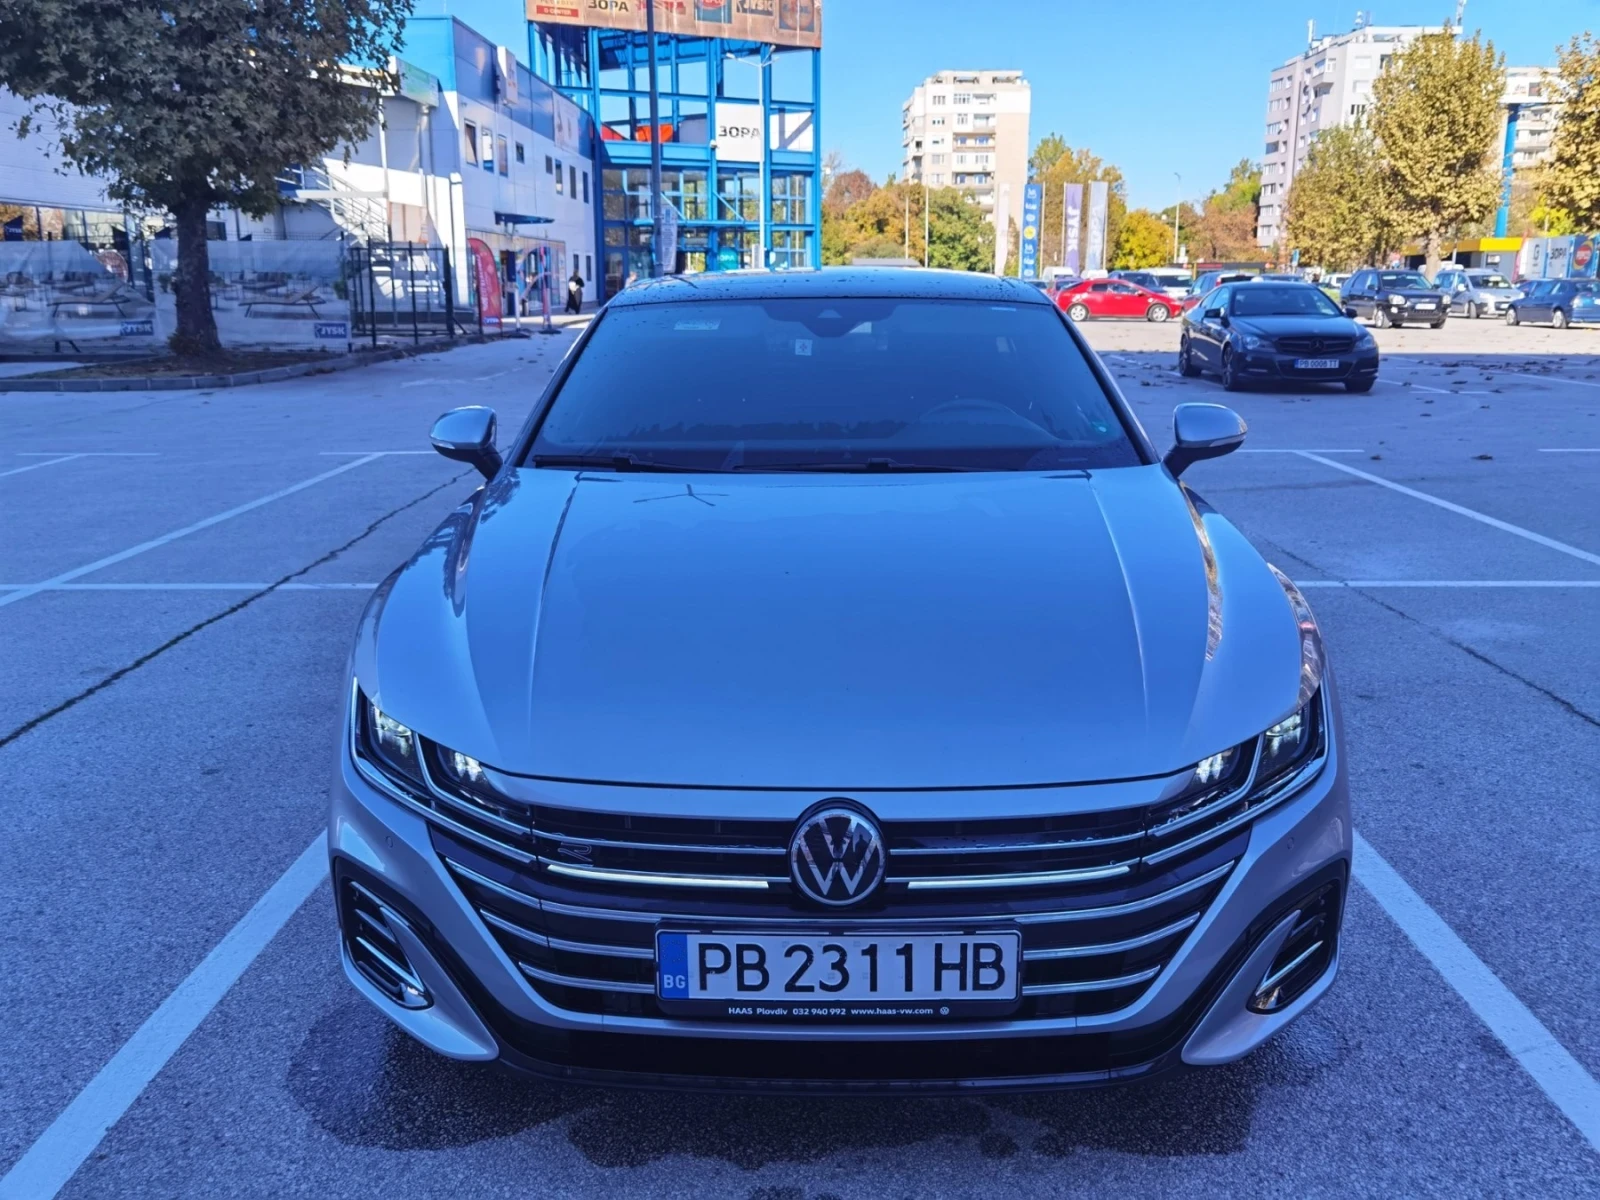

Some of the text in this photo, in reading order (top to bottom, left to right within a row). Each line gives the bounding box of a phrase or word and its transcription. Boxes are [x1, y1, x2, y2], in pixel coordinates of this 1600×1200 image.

[718, 125, 761, 138] ЗОРА
[1067, 206, 1081, 251] JYSK
[125, 323, 152, 333] JYSK
[320, 326, 346, 335] JYSK
[697, 942, 1006, 993] PB 2311 HB
[663, 974, 686, 989] BG
[728, 1007, 753, 1015] HAAS
[756, 1007, 788, 1016] Plovdiv
[792, 1008, 809, 1016] 032
[811, 1008, 828, 1016] 940
[829, 1008, 846, 1016] 992
[851, 1007, 934, 1015] www.haas-vw.com
